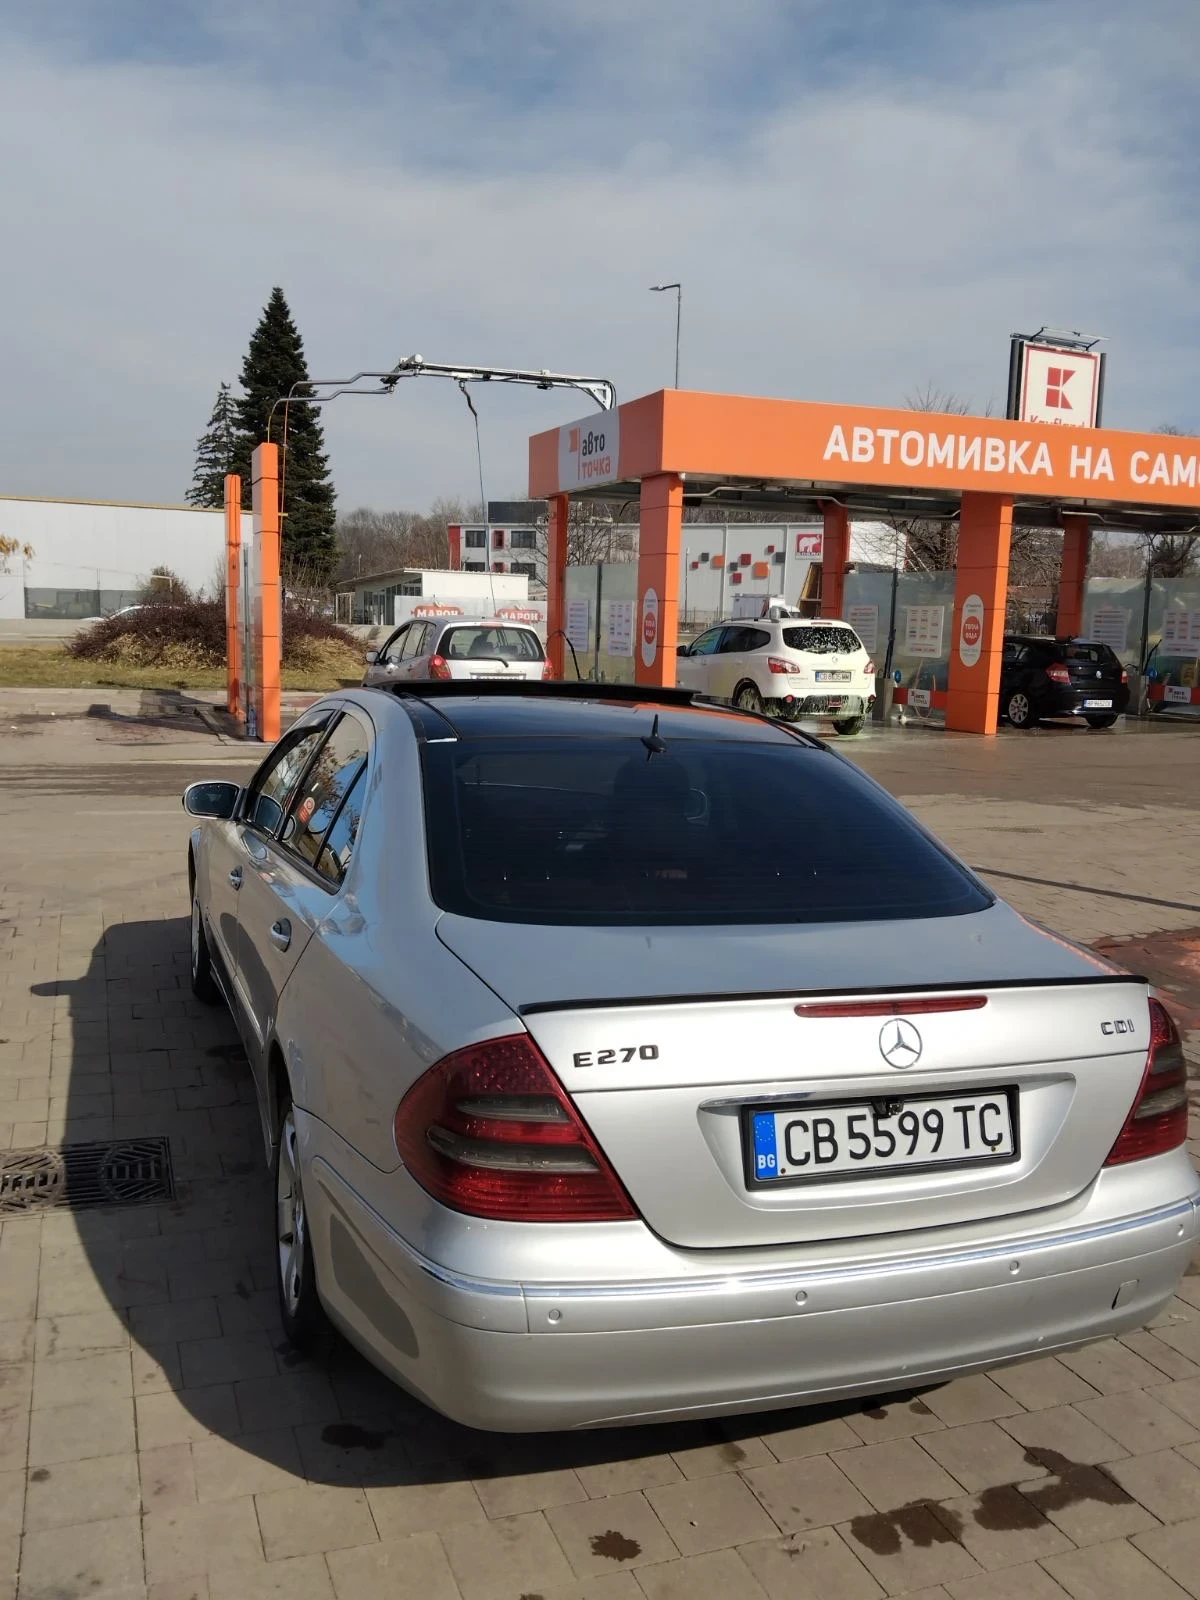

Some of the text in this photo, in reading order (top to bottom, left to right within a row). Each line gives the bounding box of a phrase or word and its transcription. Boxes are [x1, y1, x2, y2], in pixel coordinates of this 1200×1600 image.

[582, 456, 611, 480] точка
[823, 425, 1200, 488] АВТОМИВКА НА САМ
[1101, 1019, 1135, 1035] CDI
[784, 1102, 1003, 1166] CB 5599 TC
[757, 1154, 775, 1169] BG
